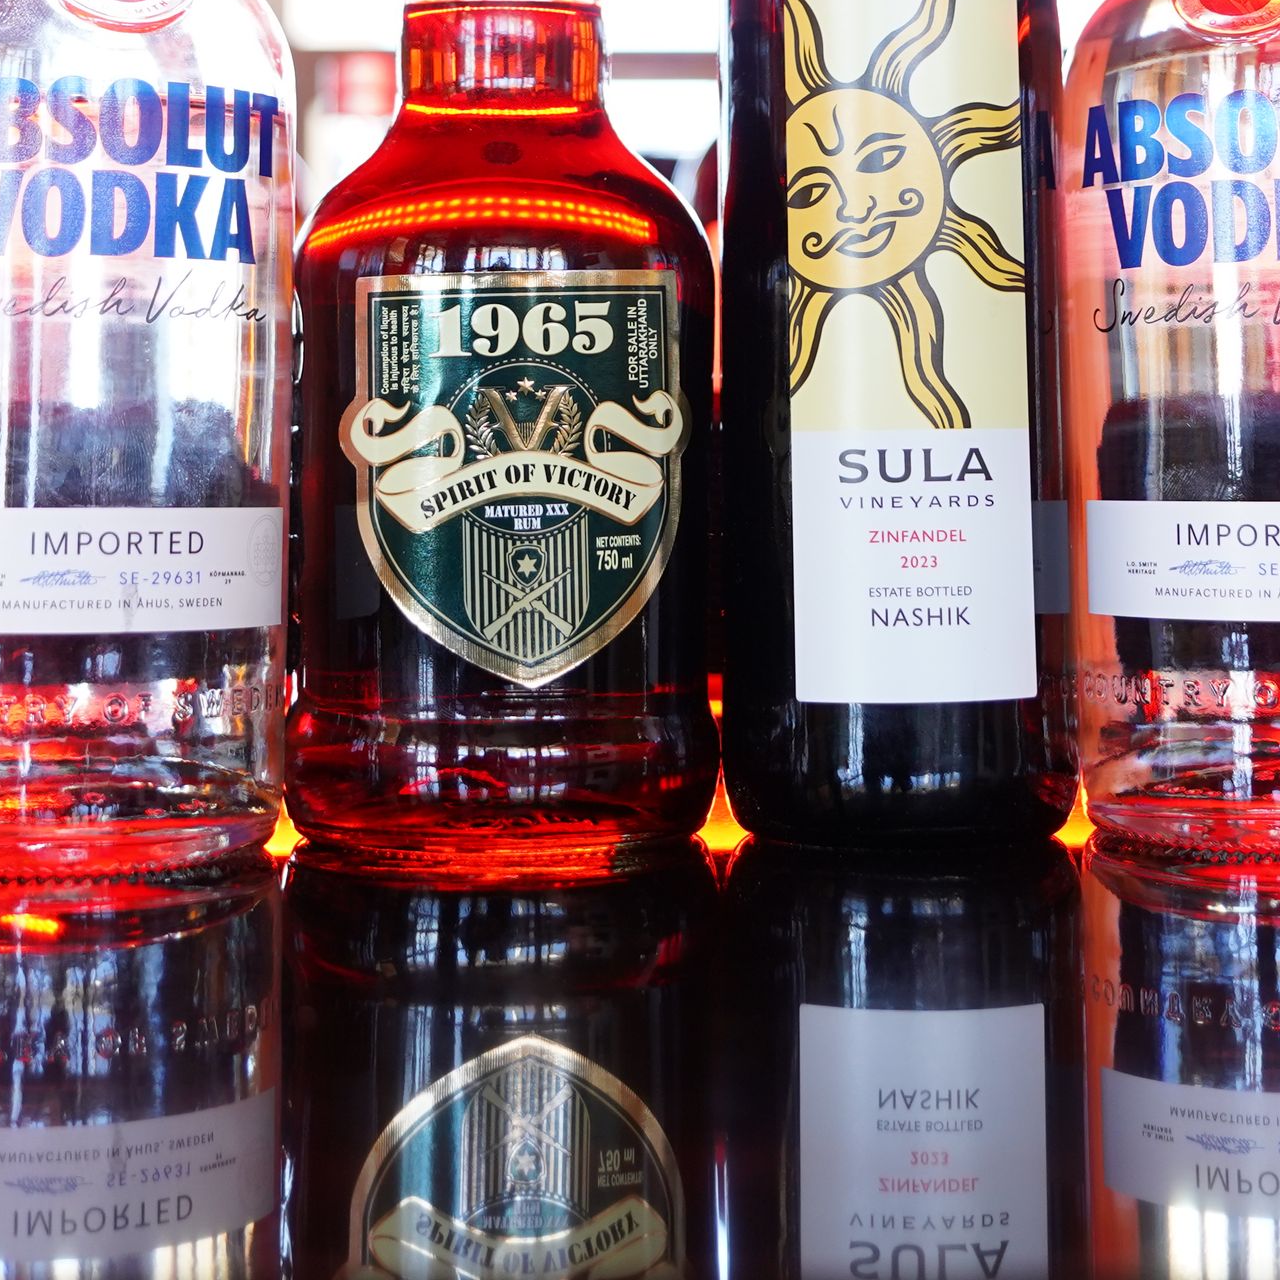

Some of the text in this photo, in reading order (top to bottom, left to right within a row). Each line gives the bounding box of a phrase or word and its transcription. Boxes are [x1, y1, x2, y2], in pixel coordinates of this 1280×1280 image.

[147, 268, 267, 324] Vodka
[1093, 278, 1261, 333] Swedish
[389, 310, 398, 335] health
[429, 301, 614, 357] 1965
[381, 306, 390, 395] Consumption of liquor
[390, 336, 398, 345] to
[627, 306, 639, 381] FOR SALE IN
[637, 298, 649, 389] UTTARAKHAND
[648, 327, 658, 359] ONLY
[390, 345, 400, 384] injurious
[838, 447, 994, 484] SULA
[420, 463, 638, 519] SPIRIT OF VICTORY
[840, 494, 995, 510] VINEYARDS
[484, 503, 570, 518] MATURED XXX
[513, 517, 541, 531] RUM
[869, 528, 967, 544] ZINFANDEL
[31, 531, 204, 556] IMPORTED
[596, 536, 608, 548] NET
[596, 550, 633, 570] 750 ml
[900, 555, 939, 569] 2023
[119, 571, 202, 585] SE-29631
[2, 597, 223, 610] MANUFACTURED IN ÅHUS, SWEDEN
[869, 586, 973, 598] ESTATE BOTTLED
[1155, 587, 1253, 599] MANUFACTURED
[1258, 589, 1271, 599] IN
[871, 606, 972, 627] NASHIK
[1084, 671, 1232, 707] COUNTRY
[102, 692, 153, 723] OF
[173, 684, 285, 720] SWEDEN
